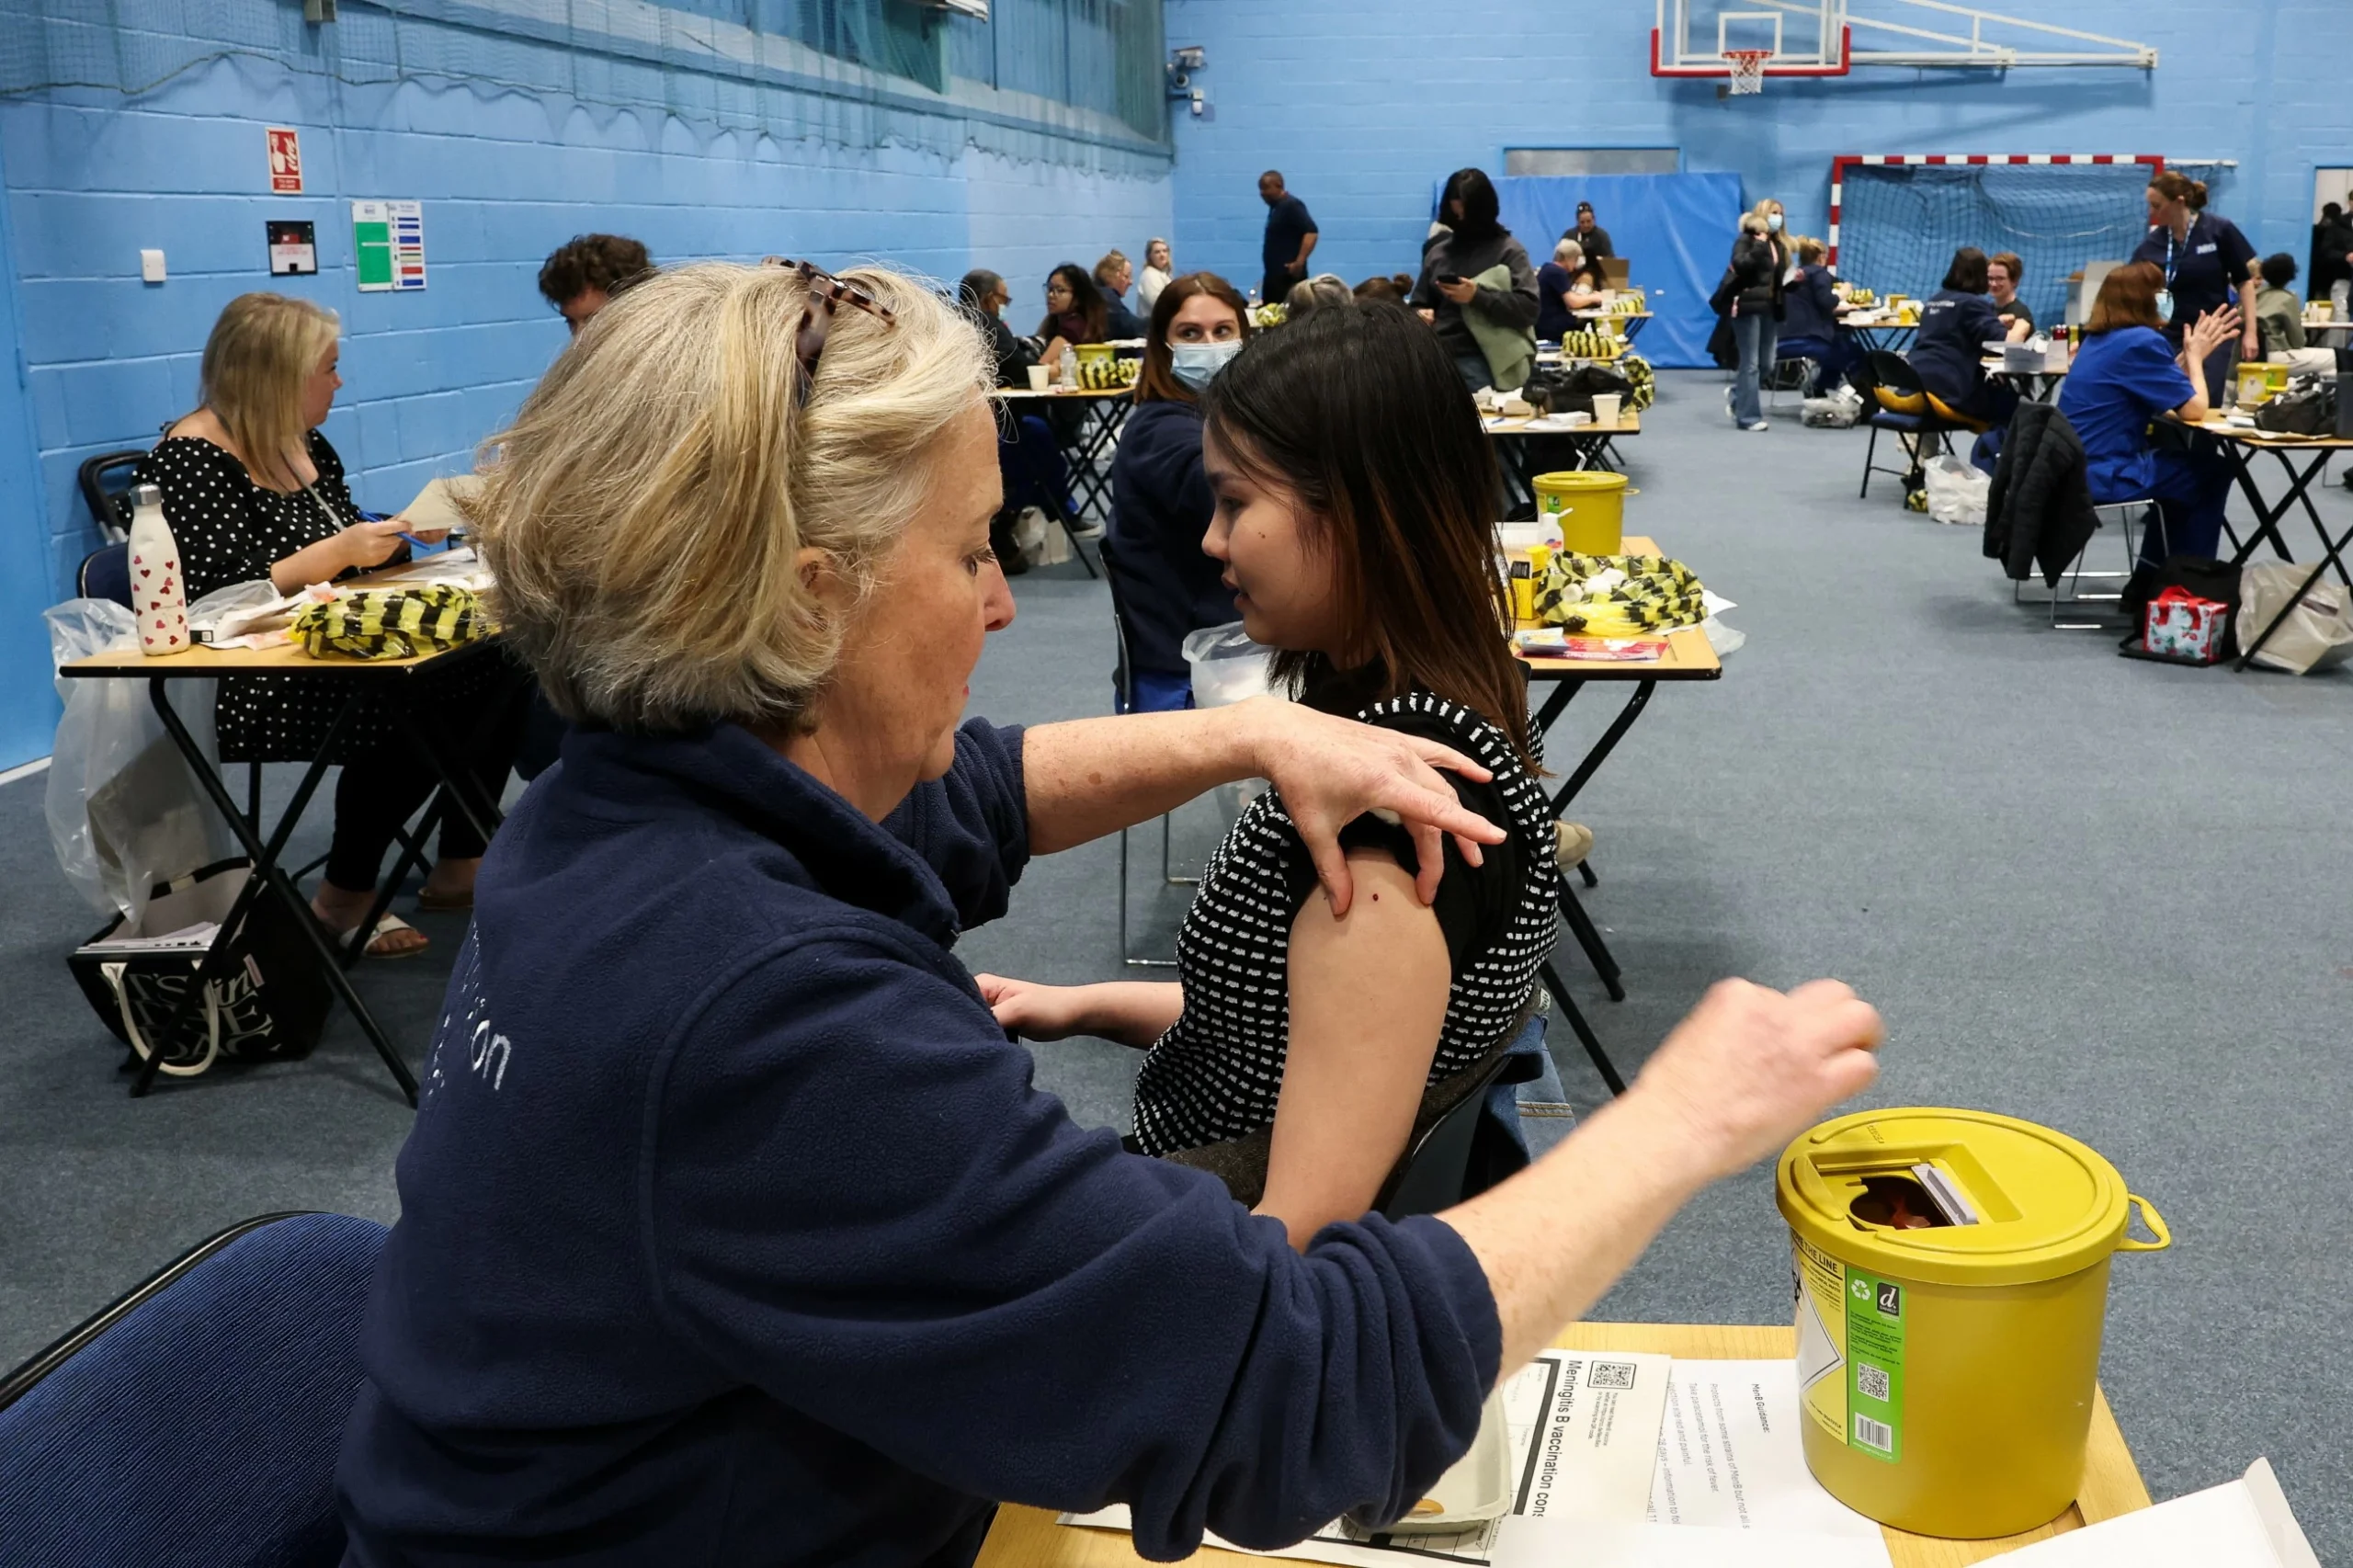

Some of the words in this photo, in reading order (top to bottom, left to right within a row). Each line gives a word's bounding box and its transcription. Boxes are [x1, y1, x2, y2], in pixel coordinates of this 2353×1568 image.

[1804, 1241, 1817, 1260] THE
[1819, 1254, 1837, 1273] LINE
[1556, 1360, 1583, 1413] Meningitis
[1688, 1382, 1699, 1395] Take
[1710, 1383, 1722, 1406] Protects
[1751, 1384, 1763, 1401] MenB
[1672, 1407, 1681, 1418] site
[1689, 1396, 1708, 1433] paracetamol
[1715, 1408, 1724, 1422] from
[1756, 1402, 1770, 1433] Guidance:
[1676, 1419, 1684, 1428] red
[1718, 1423, 1729, 1439] some
[1677, 1430, 1688, 1442] and
[1699, 1434, 1709, 1442] for
[1658, 1447, 1669, 1461] days
[1679, 1443, 1693, 1466] painful.
[1702, 1444, 1712, 1454] the
[1722, 1440, 1735, 1461] strains
[1539, 1426, 1565, 1489] vaccination
[1704, 1455, 1715, 1467] risk
[1663, 1468, 1678, 1506] information
[1709, 1475, 1719, 1493] fever.
[1730, 1471, 1742, 1489] MenB
[1734, 1491, 1744, 1501] but
[1738, 1503, 1747, 1514] not
